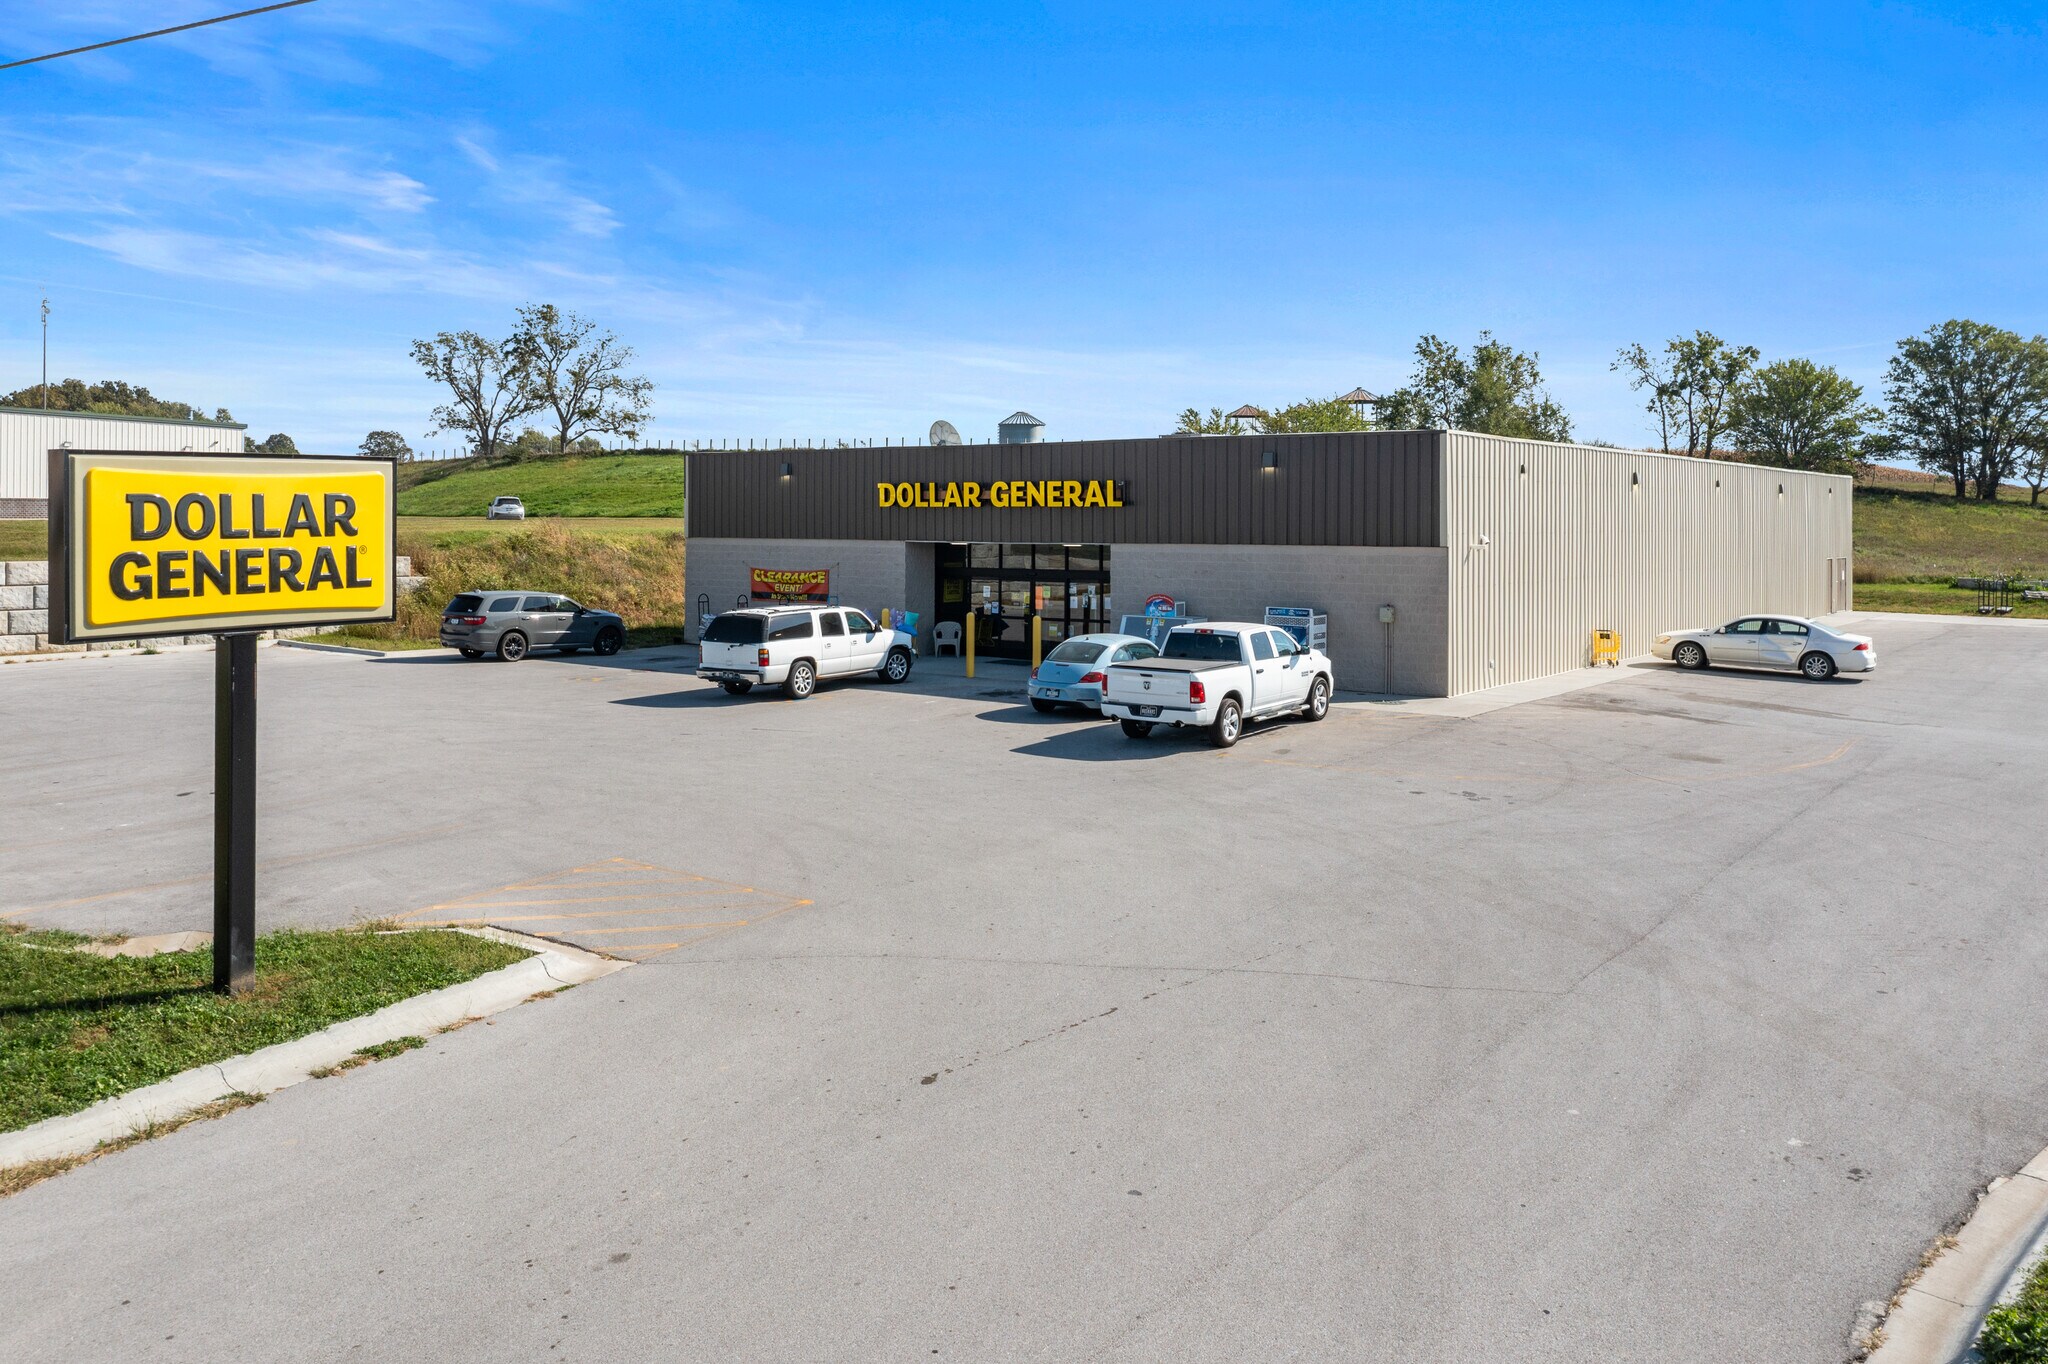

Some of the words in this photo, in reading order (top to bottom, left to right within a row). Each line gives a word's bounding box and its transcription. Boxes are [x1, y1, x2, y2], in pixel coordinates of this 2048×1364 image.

[877, 482, 981, 508] DOLLAR
[990, 480, 1123, 508] GENERAL
[125, 492, 359, 541] DOLLAR
[753, 569, 826, 584] CLEARANCE
[774, 583, 803, 592] EVENT!
